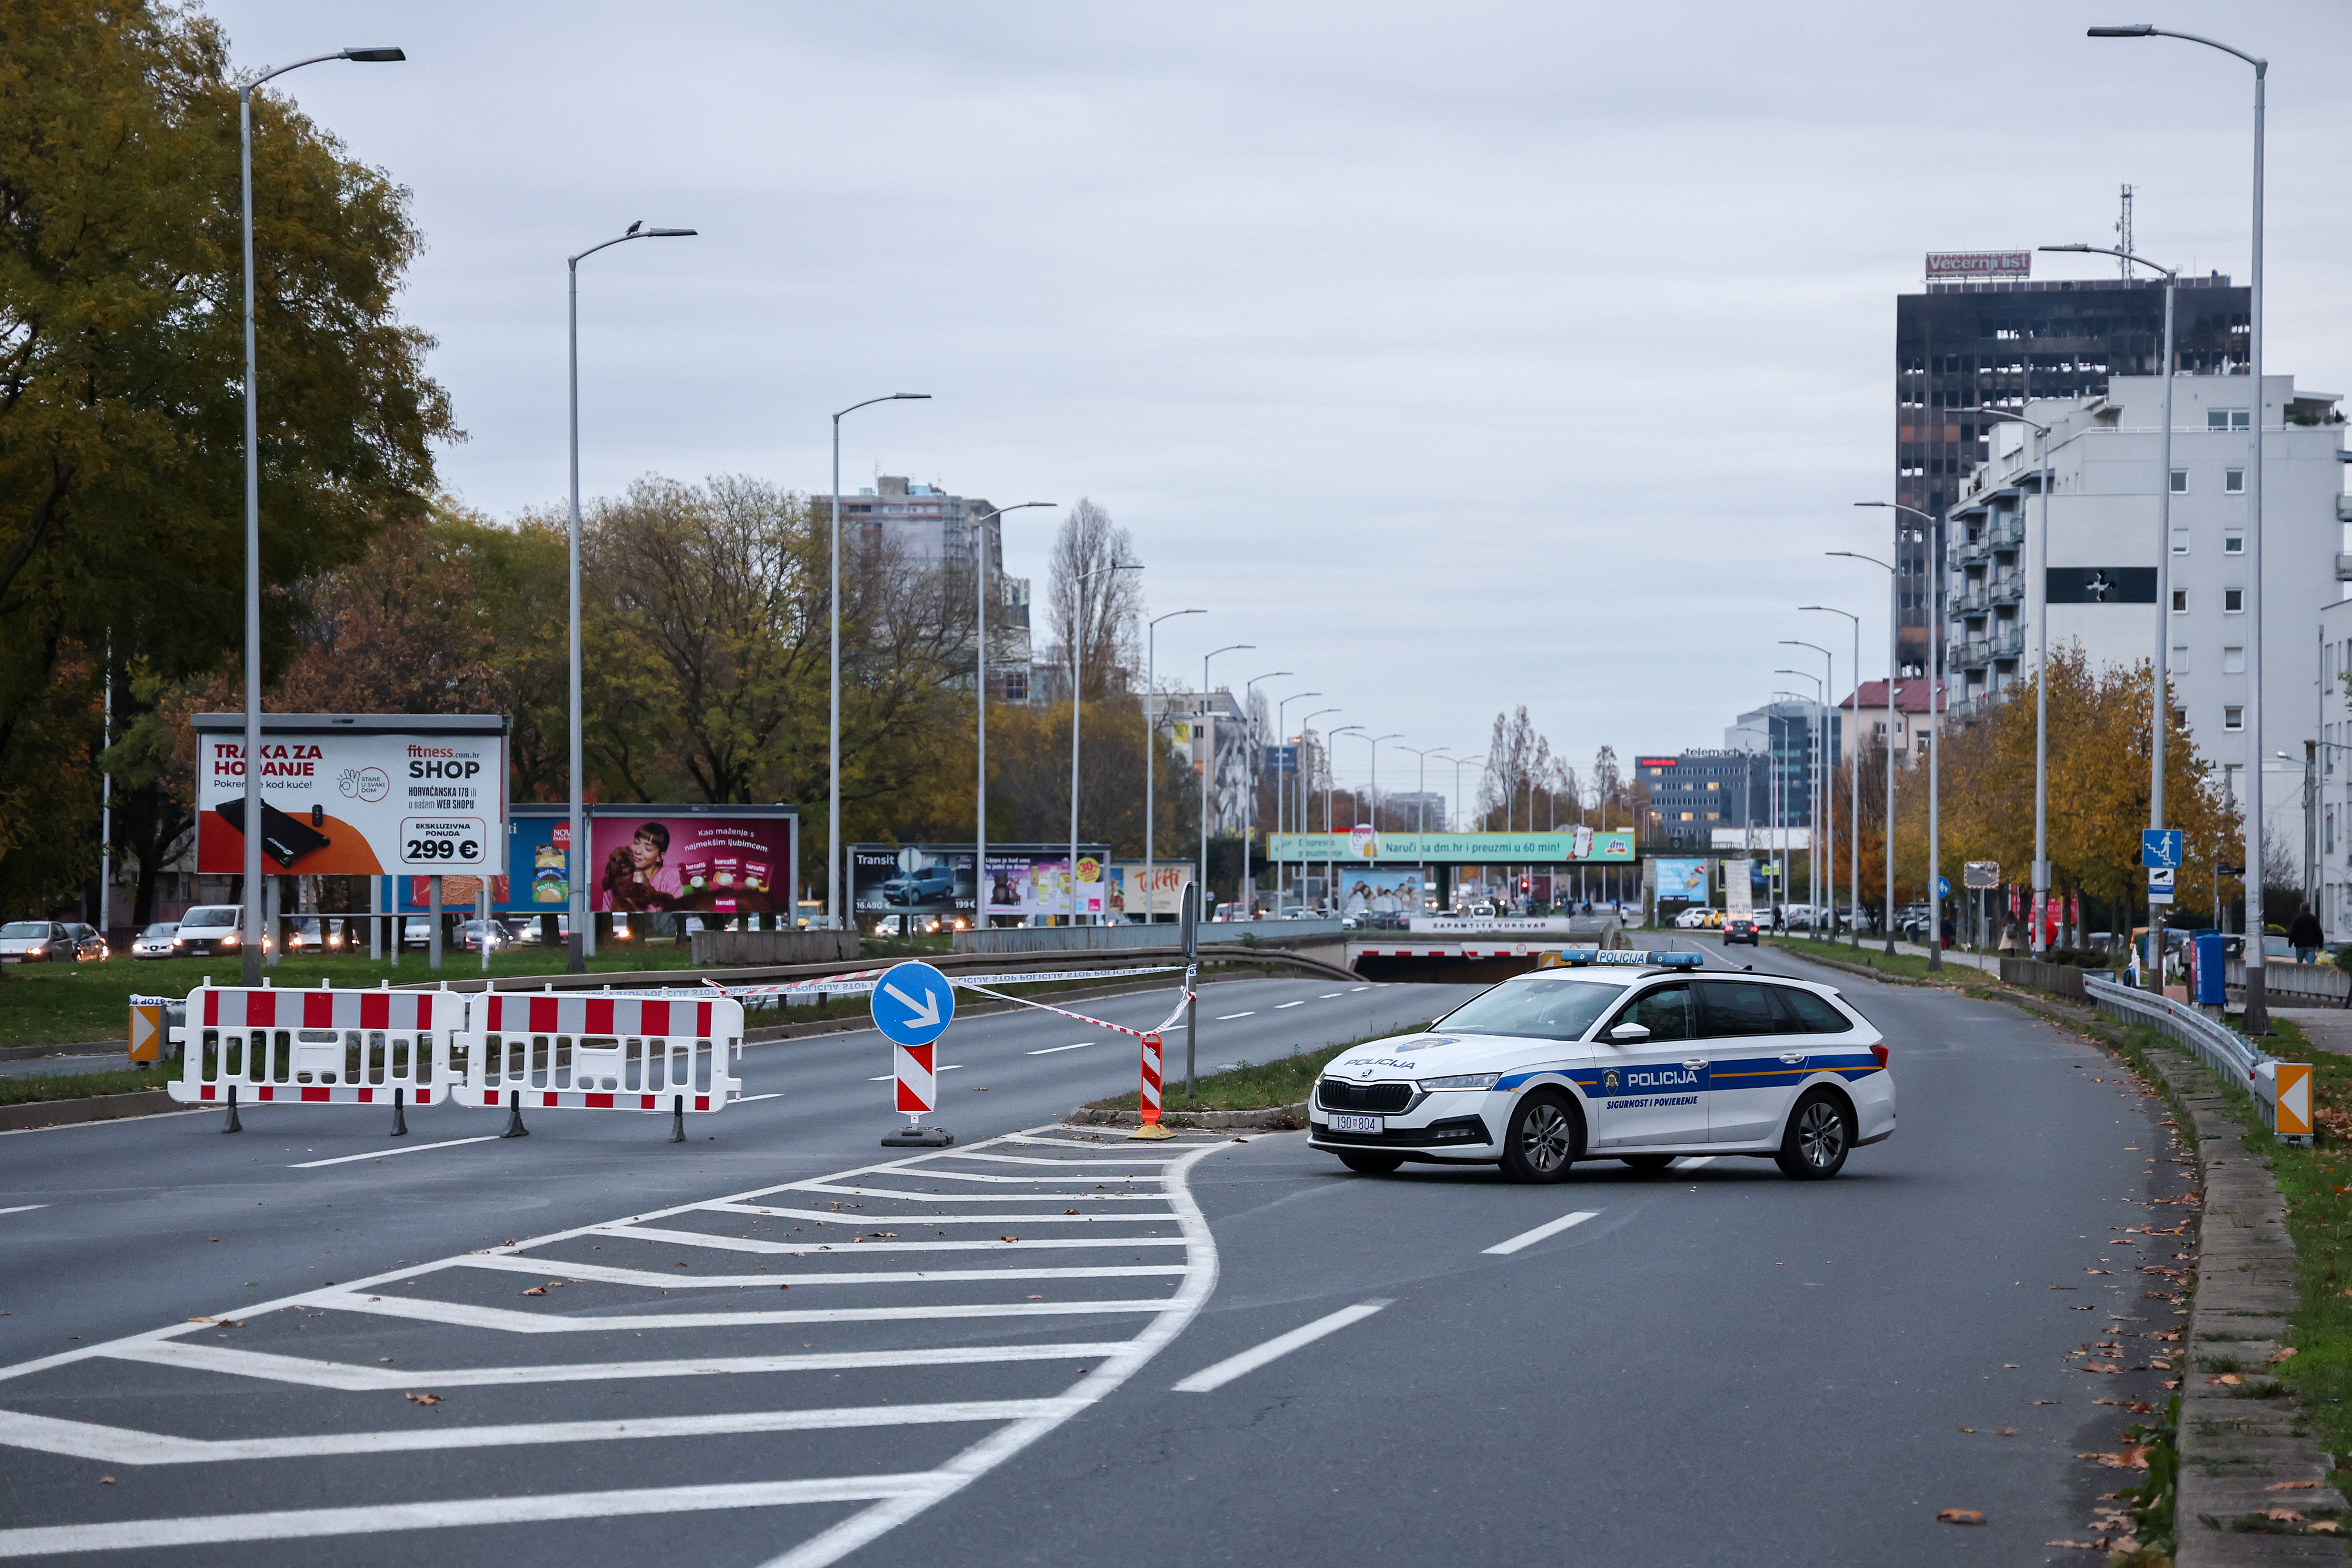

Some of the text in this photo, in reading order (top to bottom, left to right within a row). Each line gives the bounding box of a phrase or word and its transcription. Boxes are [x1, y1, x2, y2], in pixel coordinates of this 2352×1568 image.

[2002, 253, 2027, 268] list
[214, 744, 323, 759] TRKA ZA
[1686, 747, 1740, 757] telemach
[214, 761, 314, 776] HOANJE
[409, 760, 480, 779] SHOP
[266, 780, 284, 788] kod
[409, 785, 456, 797] HORVAĆANSKA
[458, 787, 469, 797] 178
[414, 799, 435, 809] našem
[436, 800, 450, 809] WEB
[452, 800, 475, 809] SHOPU
[716, 828, 748, 837] maženje
[407, 840, 478, 859] 299 €
[684, 838, 768, 852] najmekšim ljubimcem
[1386, 842, 1416, 852] Naruči
[1472, 842, 1511, 854] preuzmi
[1524, 842, 1535, 852] 60
[1538, 842, 1559, 852] min!
[1610, 840, 1624, 848] dm
[856, 854, 894, 865] Transit
[536, 882, 553, 892] Paris
[856, 901, 882, 910] 16.490
[1599, 952, 1645, 964] POLICIJA
[1344, 1058, 1416, 1070] POLICIJA
[1628, 1071, 1698, 1087] POLICIJA
[1606, 1096, 1698, 1109] SIGURNOST I POVJERENJE
[1337, 1116, 1375, 1130] 190 804
